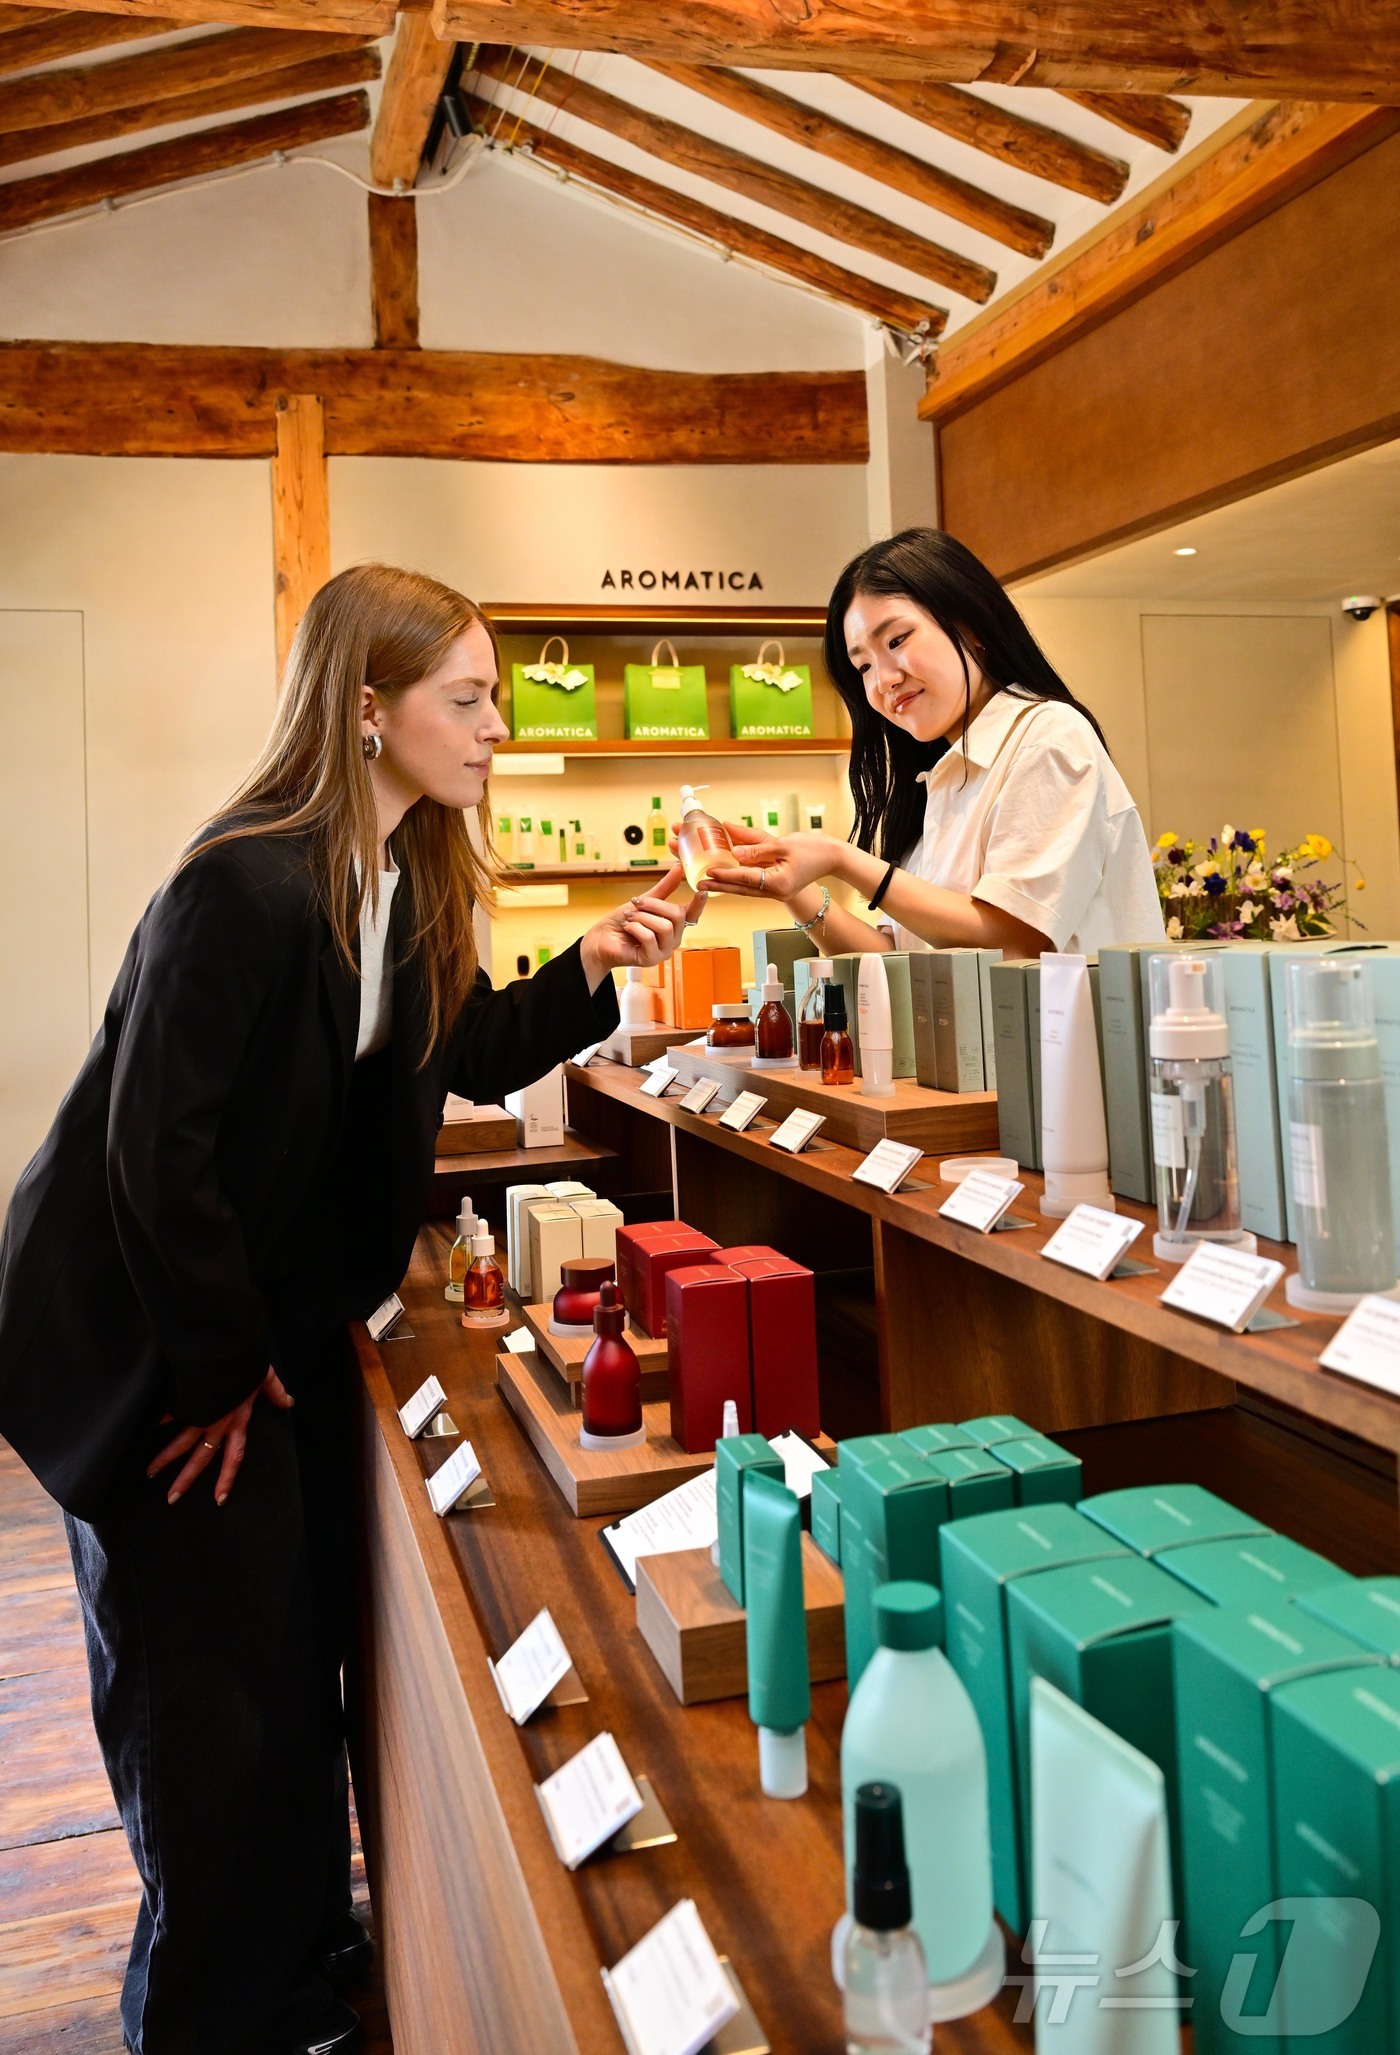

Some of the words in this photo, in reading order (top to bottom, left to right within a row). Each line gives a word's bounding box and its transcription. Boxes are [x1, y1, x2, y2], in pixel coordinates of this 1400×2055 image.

[601, 569, 764, 591] AROMATICA
[518, 726, 594, 739] AROMATICA
[634, 725, 706, 738] AROMATICA
[740, 725, 812, 736] AROMATICA
